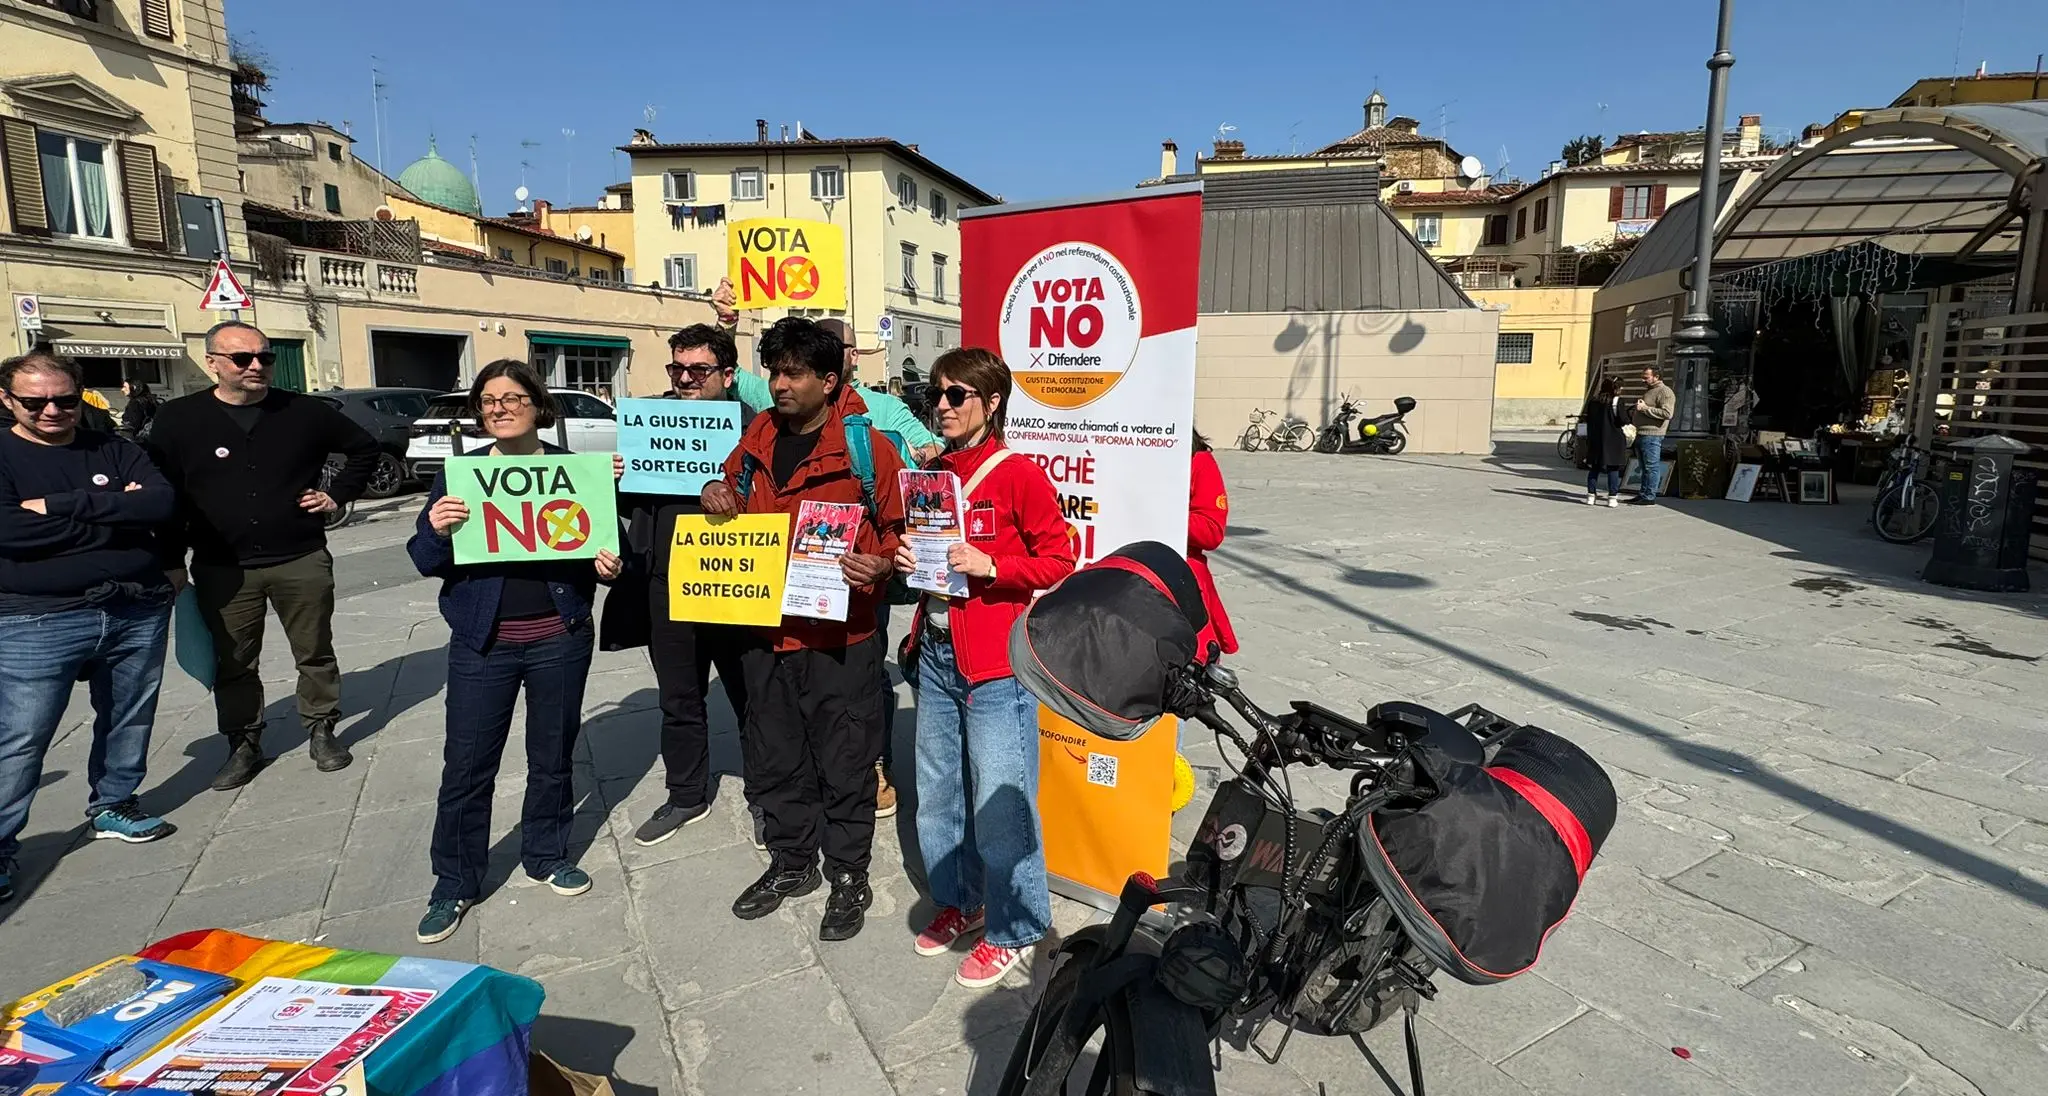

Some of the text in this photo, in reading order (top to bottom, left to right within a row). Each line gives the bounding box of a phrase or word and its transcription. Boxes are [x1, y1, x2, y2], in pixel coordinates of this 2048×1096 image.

[738, 227, 810, 254] VOTA
[741, 255, 820, 302] NO
[1003, 247, 1137, 324] Società civile per il NO nel referendum costituzionale
[1032, 277, 1105, 303] VOTA
[1029, 304, 1104, 348] NO
[60, 345, 93, 354] PANE
[101, 346, 138, 355] PIZZA
[145, 348, 181, 357] DOLCI
[1048, 352, 1102, 367] Difendere
[1025, 376, 1104, 385] GIUSTIZIA, COSTITUZIONE
[1046, 386, 1087, 394] DEMOCRAZIA
[624, 414, 734, 430] LA GIUSTIZIA
[1011, 417, 1045, 429] MARZO
[1047, 422, 1078, 431] saremo
[1079, 419, 1119, 432] chiamati
[1121, 425, 1128, 433] a
[1131, 424, 1163, 434] votare
[1165, 422, 1175, 435] al
[650, 437, 707, 452] NON SI
[1007, 430, 1066, 442] CONFERMATIVO
[1067, 433, 1088, 443] SULLA
[1024, 449, 1096, 484] RCHÈ
[474, 466, 576, 498] VOTA
[483, 499, 591, 553] NO
[676, 532, 781, 546] LA GIUSTIZIA
[700, 557, 754, 572] NON SI
[682, 582, 770, 599] SORTEGGIA
[114, 979, 195, 1022] NO
